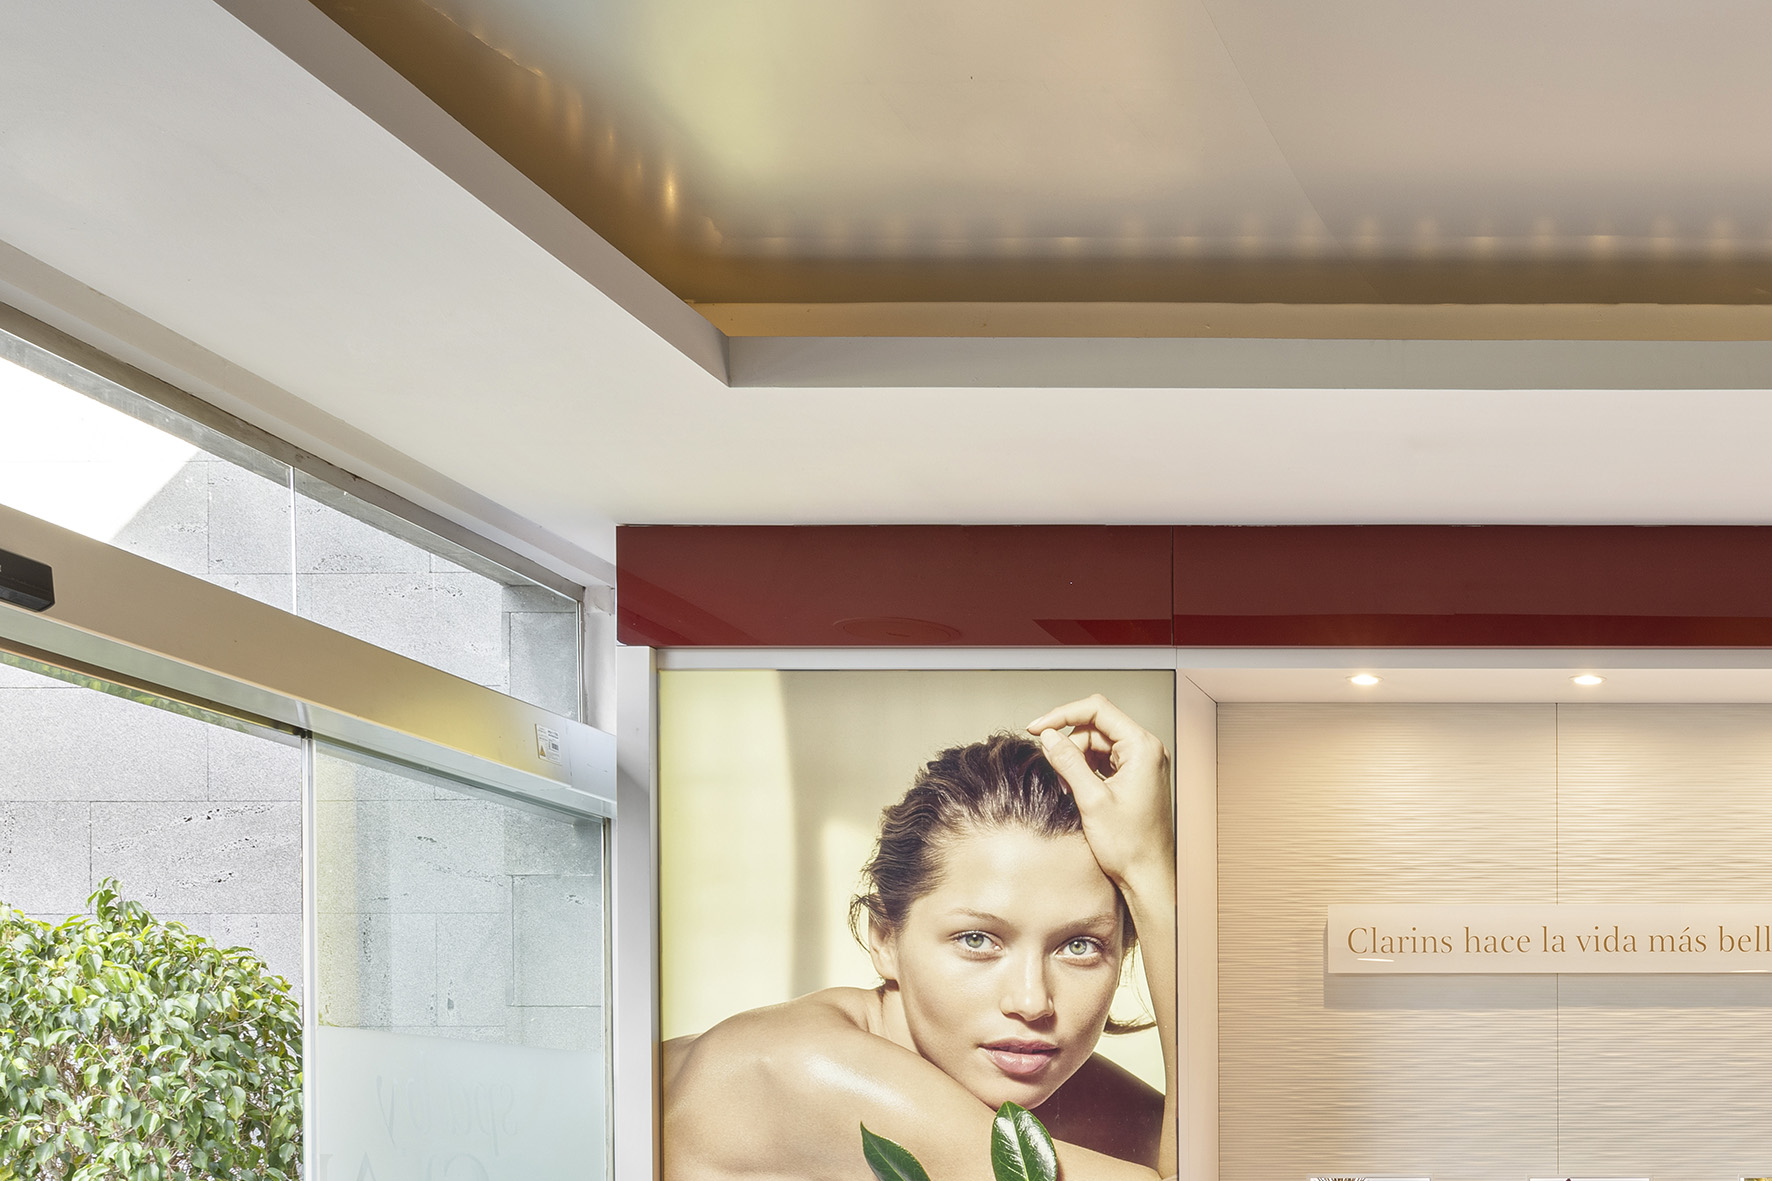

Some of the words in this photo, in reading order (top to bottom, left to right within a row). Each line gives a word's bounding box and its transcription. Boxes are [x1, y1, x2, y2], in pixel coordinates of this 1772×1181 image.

[1347, 926, 1454, 955] Clarins
[1463, 926, 1531, 954] hace
[1542, 925, 1567, 954] la
[1576, 925, 1638, 954] vida
[1648, 926, 1708, 954] más
